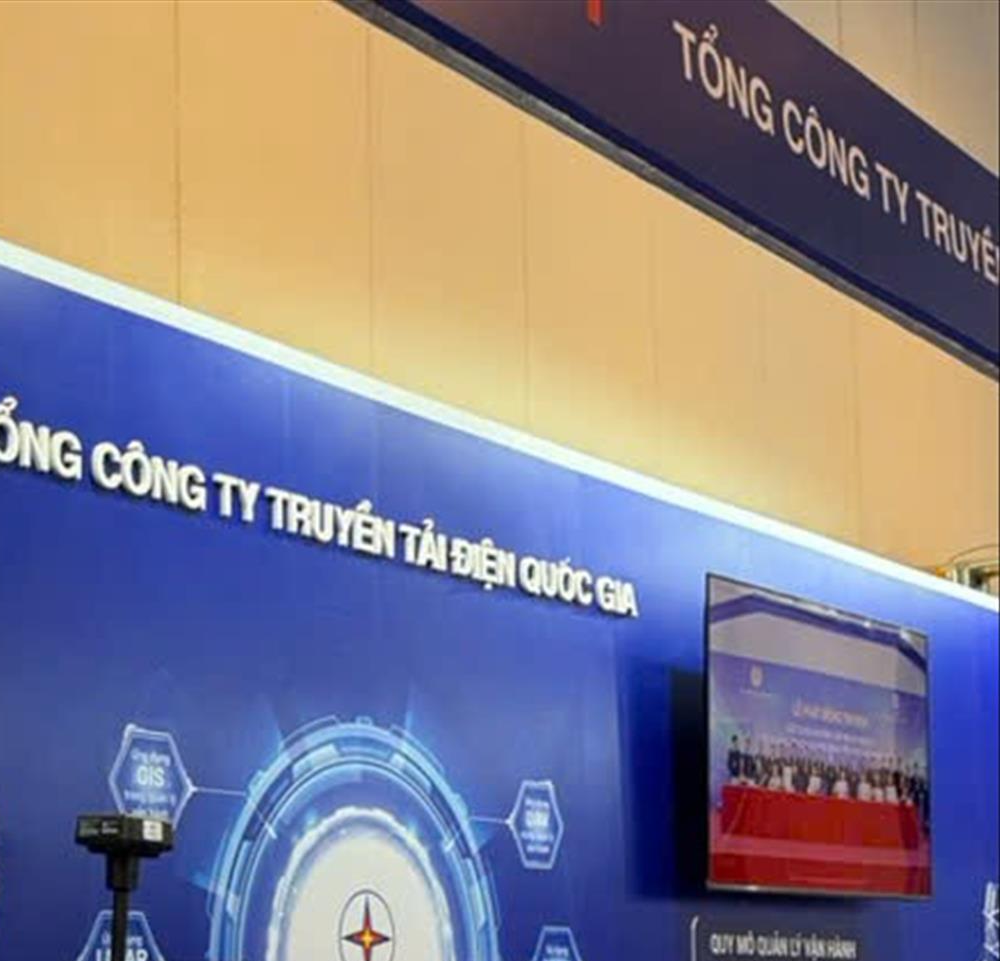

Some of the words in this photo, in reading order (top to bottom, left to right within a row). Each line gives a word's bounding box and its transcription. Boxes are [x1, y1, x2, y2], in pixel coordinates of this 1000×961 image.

[671, 20, 775, 136] TỔNG
[782, 100, 870, 200] CÔNG
[875, 162, 909, 224] TY
[91, 440, 207, 511] CÔNG
[213, 473, 260, 522] TY
[399, 517, 447, 572] TẢI
[450, 536, 516, 591] ĐIỆN
[519, 556, 594, 606] QUỐC
[595, 575, 639, 617] GIA
